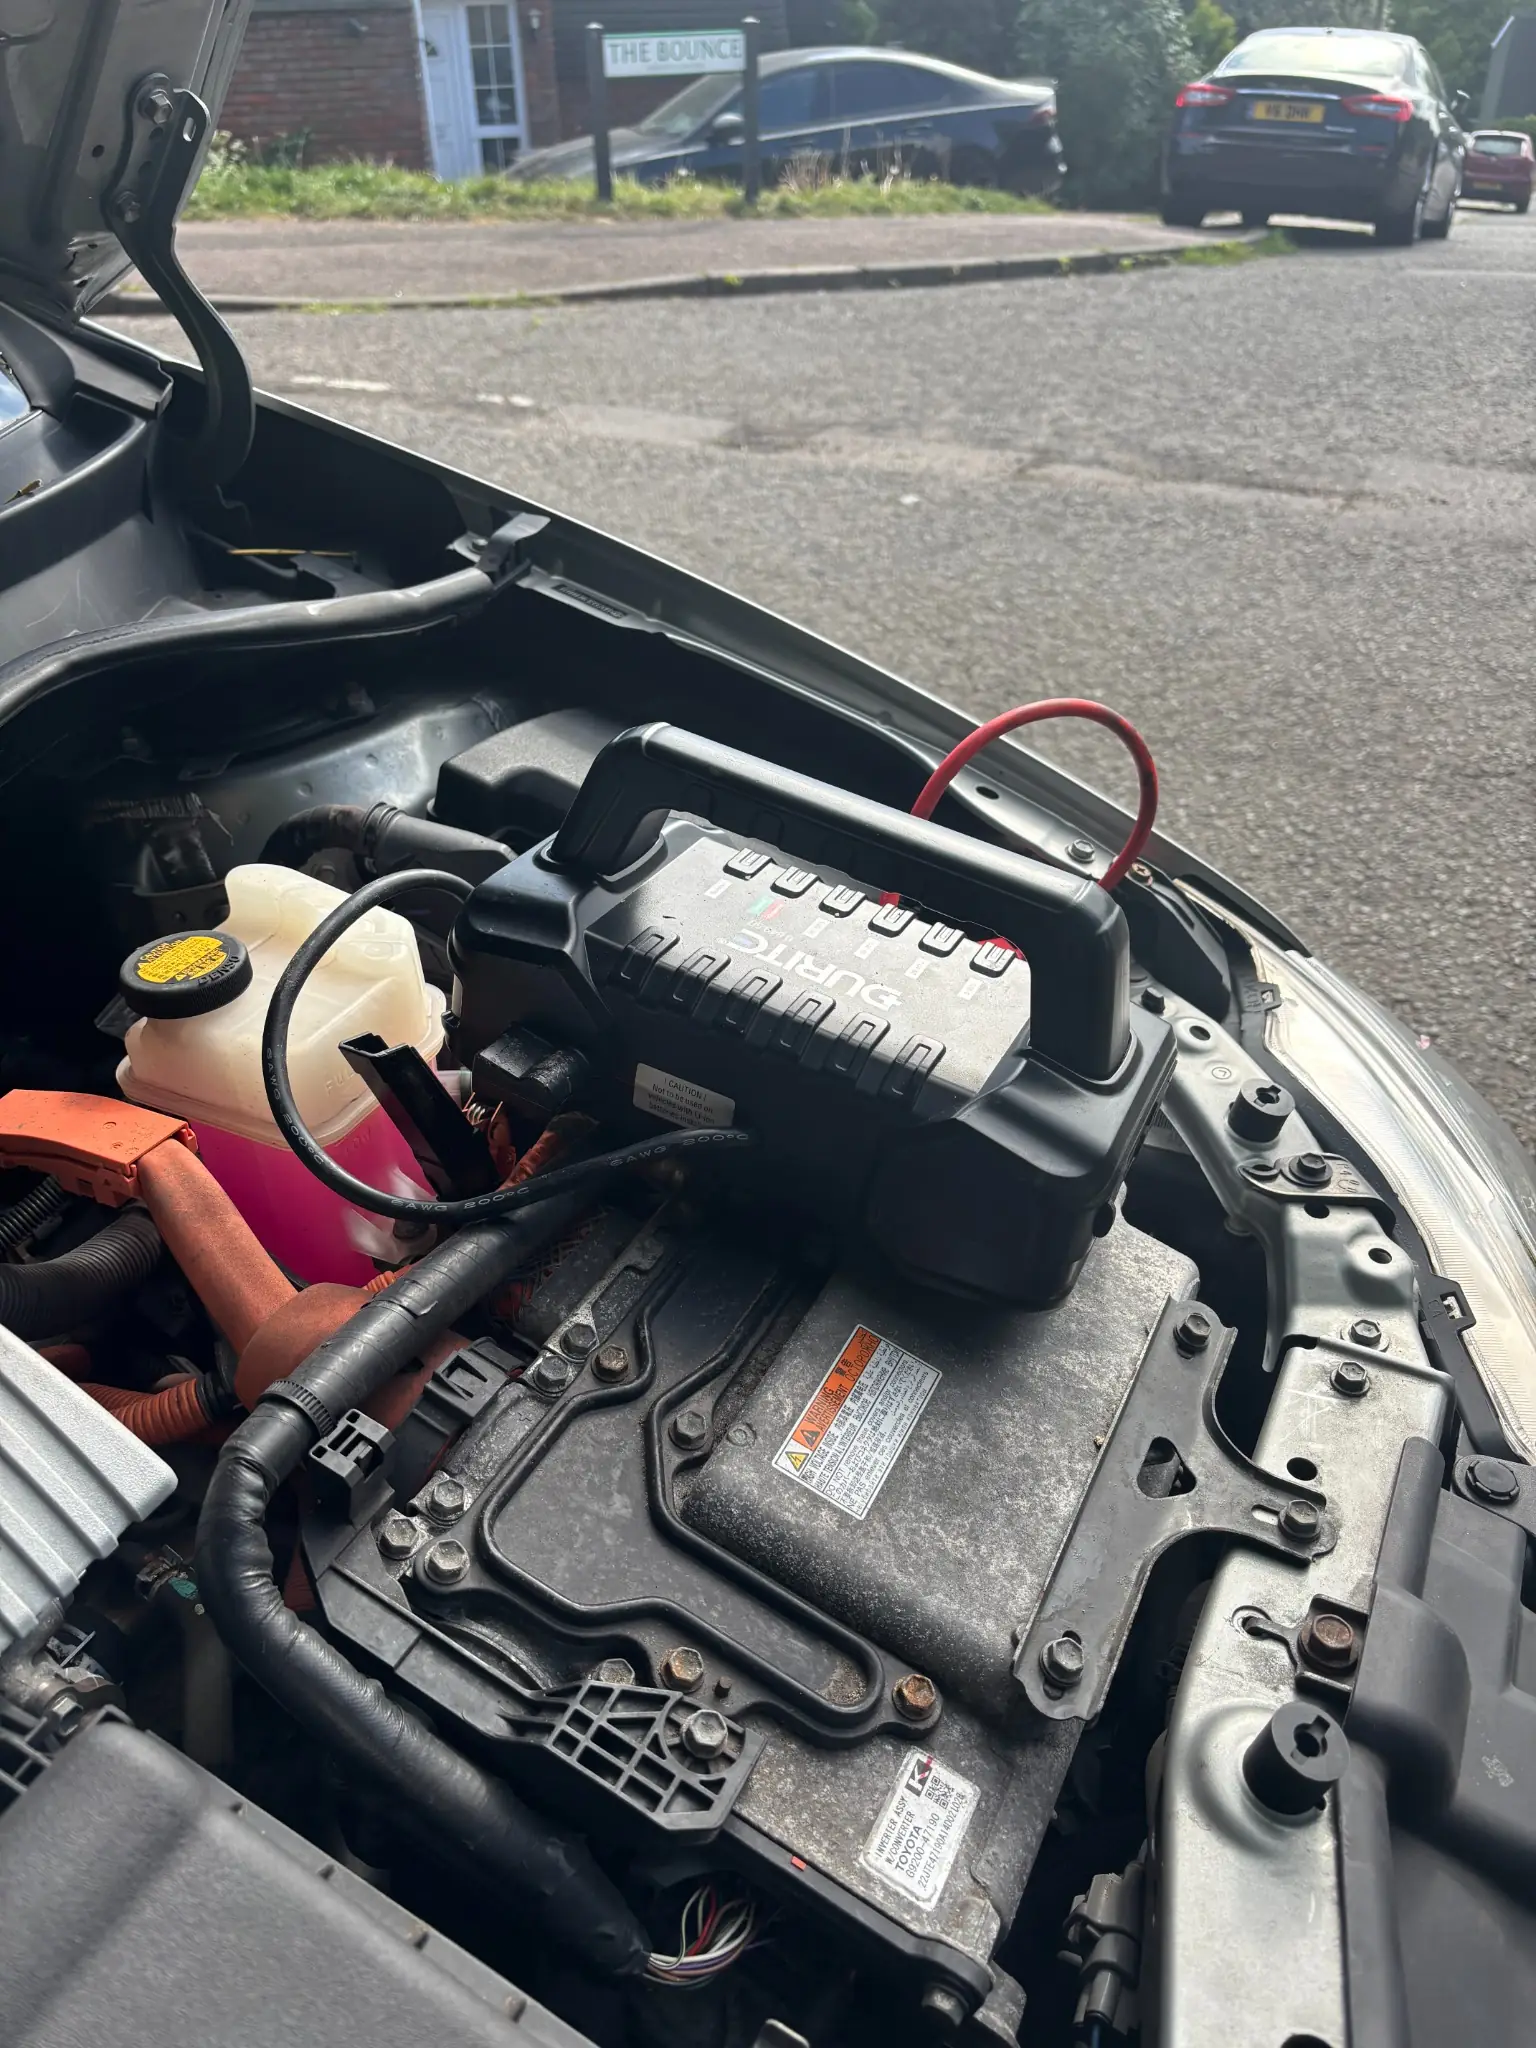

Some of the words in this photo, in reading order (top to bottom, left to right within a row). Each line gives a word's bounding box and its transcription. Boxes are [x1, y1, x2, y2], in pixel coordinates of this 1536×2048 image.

[609, 42, 651, 64] THE
[656, 38, 743, 62] BOUNCE
[198, 956, 240, 986] DENSO
[652, 1083, 665, 1095] Not
[666, 1090, 674, 1098] to
[675, 1093, 684, 1103] be
[685, 1097, 702, 1110] used
[703, 1106, 713, 1114] on
[668, 1079, 702, 1100] CAUTION
[677, 1104, 693, 1116] with
[803, 1385, 834, 1426] WARNING
[818, 1383, 850, 1432] AVERTISSEMENT
[808, 1445, 830, 1471] VOLTAGE
[821, 1430, 839, 1450] INSIDE
[812, 1470, 829, 1490] HAUTE
[821, 1450, 841, 1475] TENSION
[825, 1483, 837, 1496] DO
[832, 1467, 846, 1483] NOT
[842, 1443, 860, 1467] remove
[855, 1425, 870, 1444] these
[866, 1406, 882, 1427] covers
[845, 1496, 858, 1510] NE
[852, 1480, 867, 1497] PAS
[862, 1456, 881, 1481] enlever
[874, 1818, 898, 1858] INVERTER
[894, 1794, 909, 1818] ASSY
[884, 1810, 916, 1865] W/CONVERTER
[905, 1811, 941, 1879] G9200-47190
[894, 1825, 923, 1872] TOYOTA
